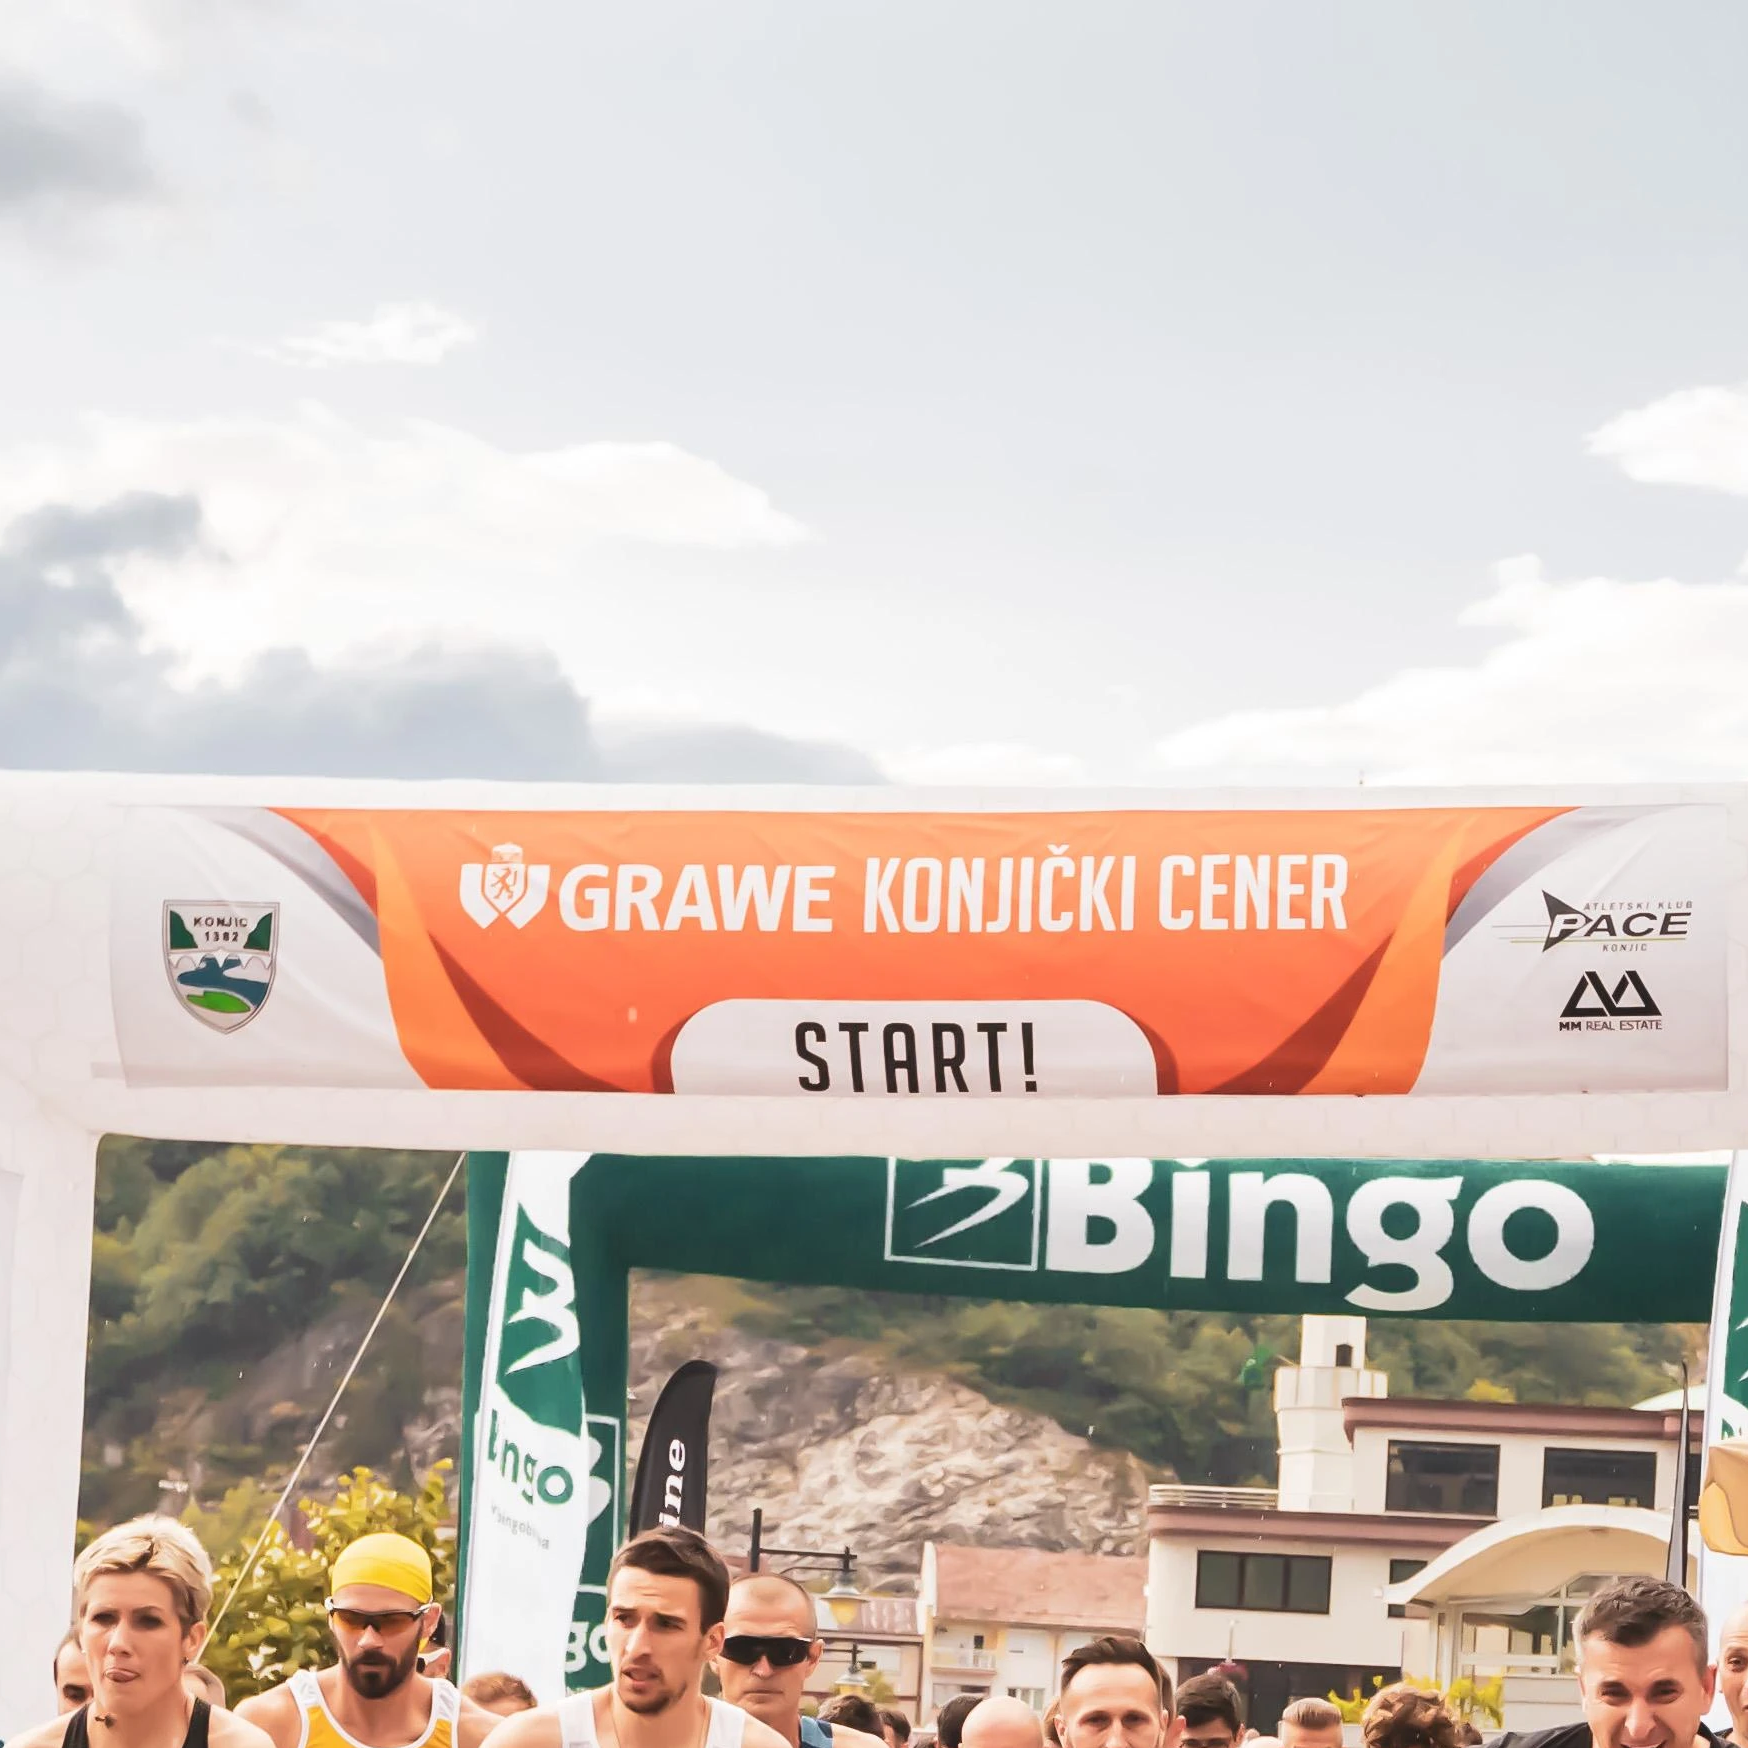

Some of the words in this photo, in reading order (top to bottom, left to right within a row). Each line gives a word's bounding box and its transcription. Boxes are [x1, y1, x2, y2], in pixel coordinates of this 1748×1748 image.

[559, 863, 836, 934] GRAWE
[862, 843, 1137, 935] KONJIČKI
[1158, 852, 1351, 931] CENER
[1583, 901, 1651, 911] ATLETSKI
[1658, 900, 1693, 910] KLUB
[193, 916, 248, 928] KONJIC
[1549, 912, 1692, 938] PACE
[1602, 943, 1648, 953] KONJIC
[1559, 1021, 1582, 1032] MM
[1585, 1020, 1616, 1031] REAL
[1619, 1019, 1663, 1031] ESTATE
[796, 1018, 1039, 1094] START!
[1047, 1157, 1595, 1311] Bingo
